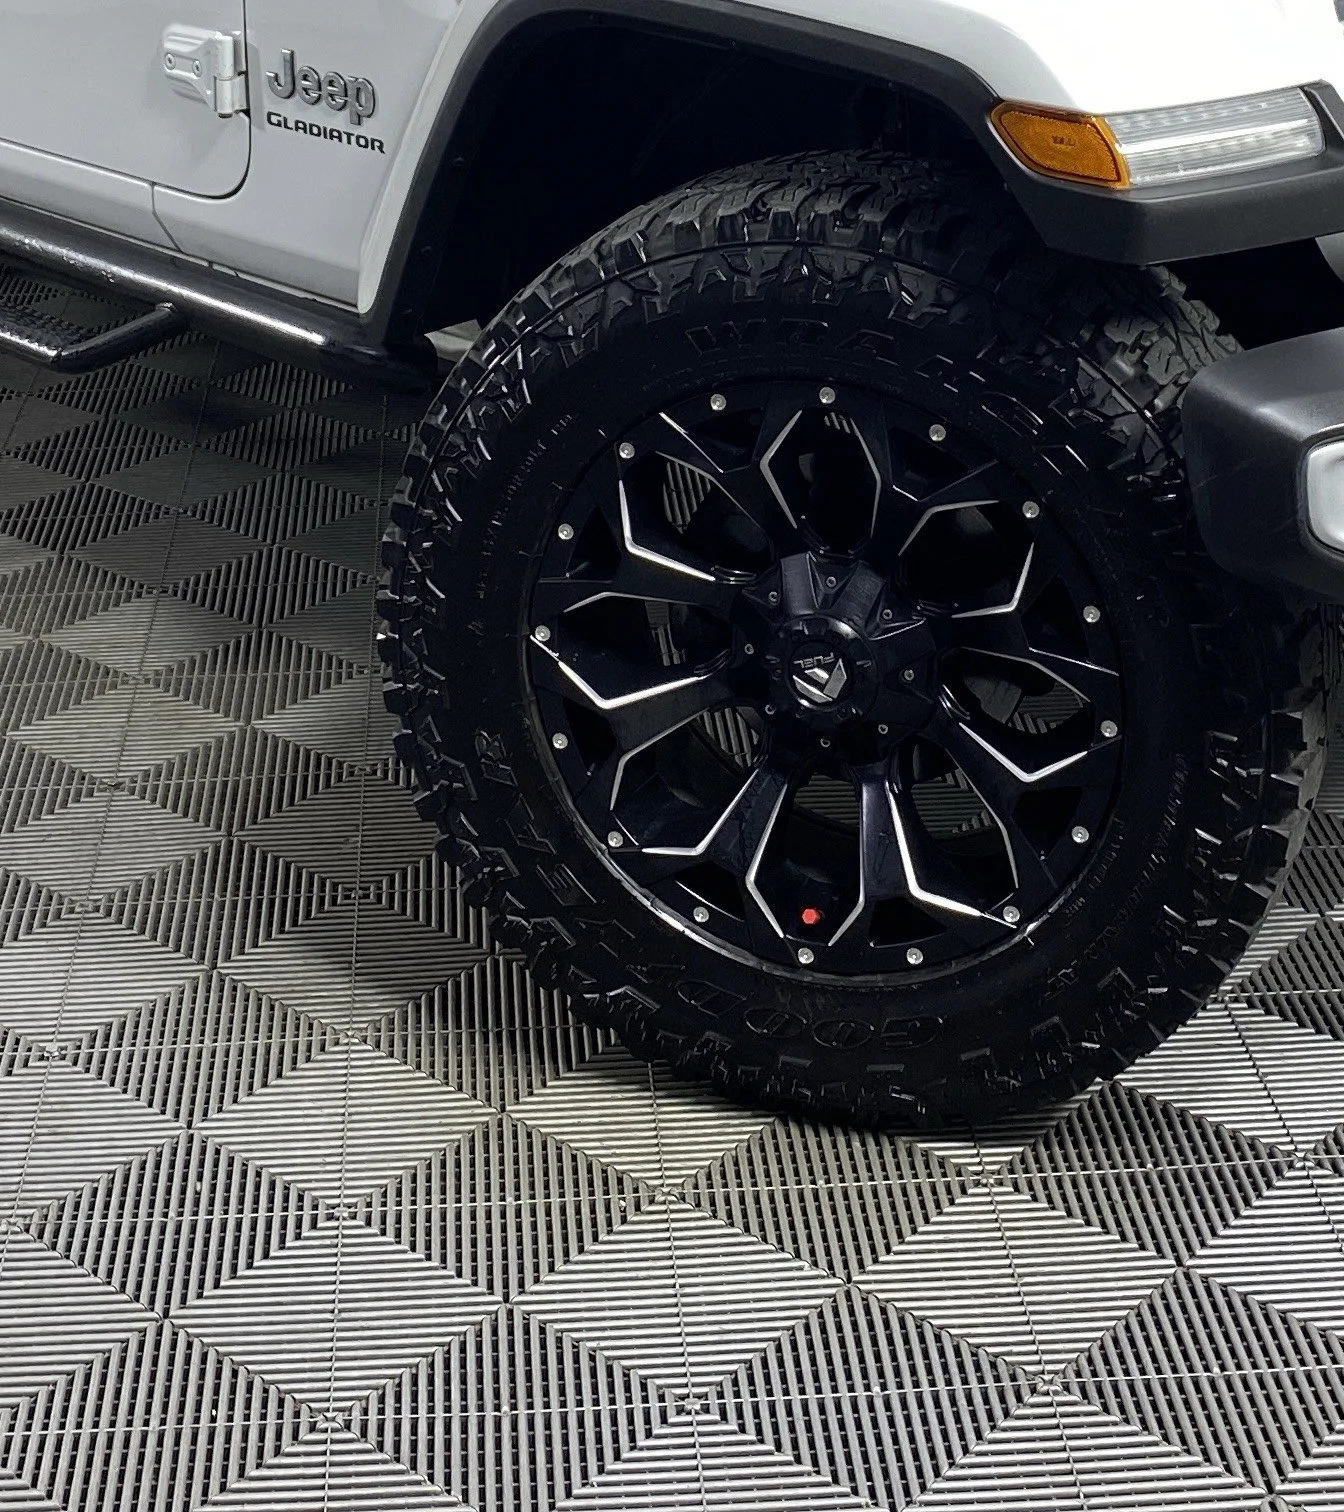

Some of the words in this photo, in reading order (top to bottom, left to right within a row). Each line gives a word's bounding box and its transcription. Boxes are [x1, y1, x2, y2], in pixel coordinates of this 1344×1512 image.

[266, 48, 376, 126] Jeep
[266, 110, 386, 155] GLADIATOR
[793, 652, 835, 669] FUEL
